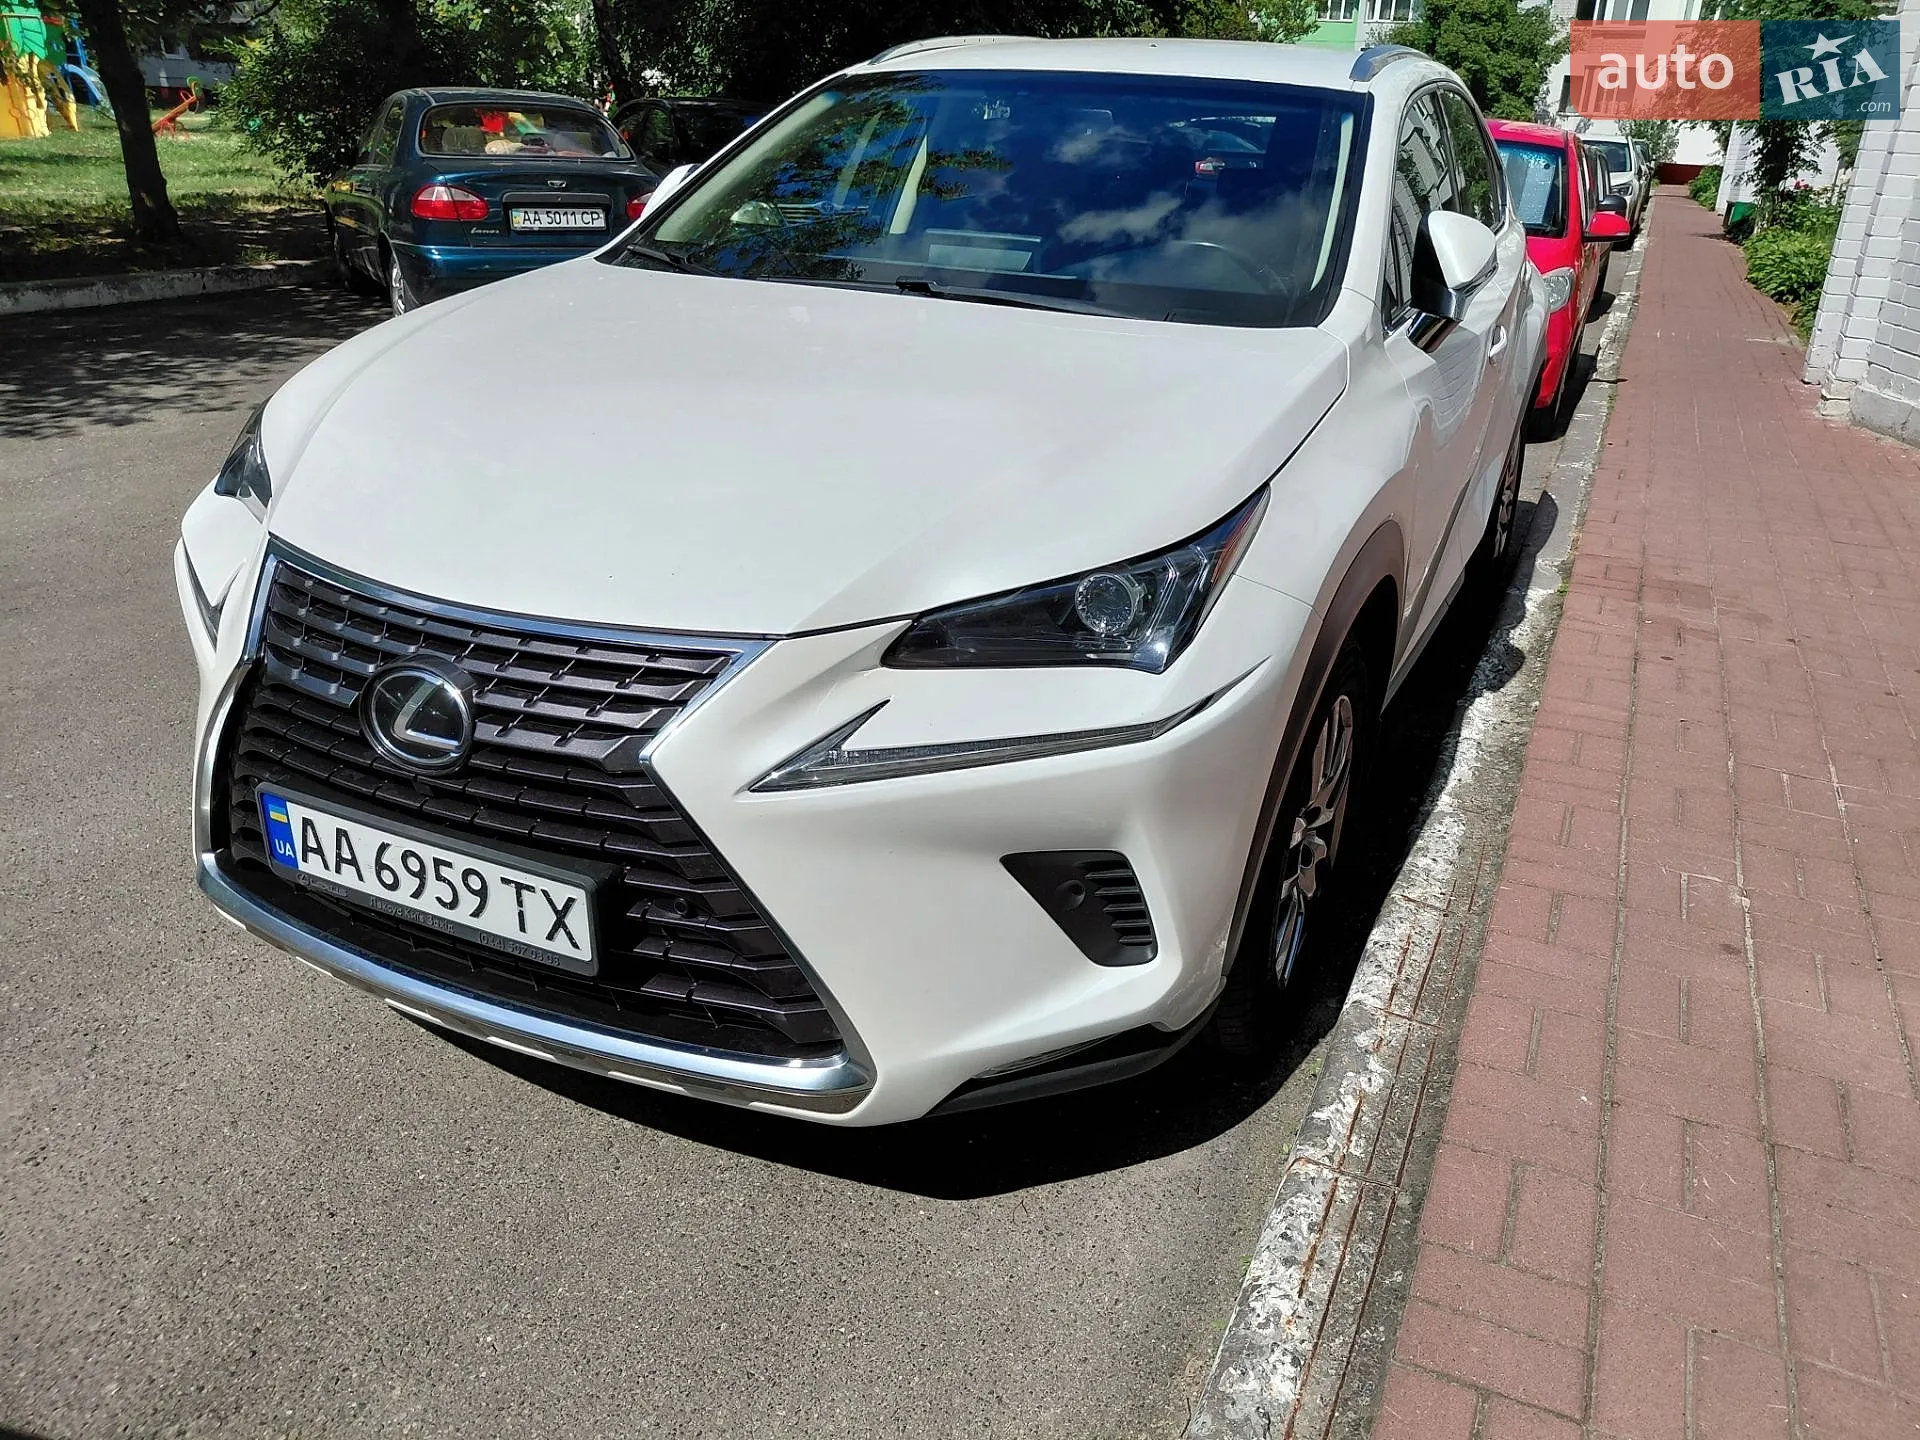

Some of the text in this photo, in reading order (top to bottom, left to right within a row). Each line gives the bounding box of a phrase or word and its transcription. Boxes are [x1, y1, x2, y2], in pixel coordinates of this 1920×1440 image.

[523, 210, 600, 225] AA 5011 CP
[274, 838, 295, 859] UA
[301, 816, 581, 951] AA 6959 TX
